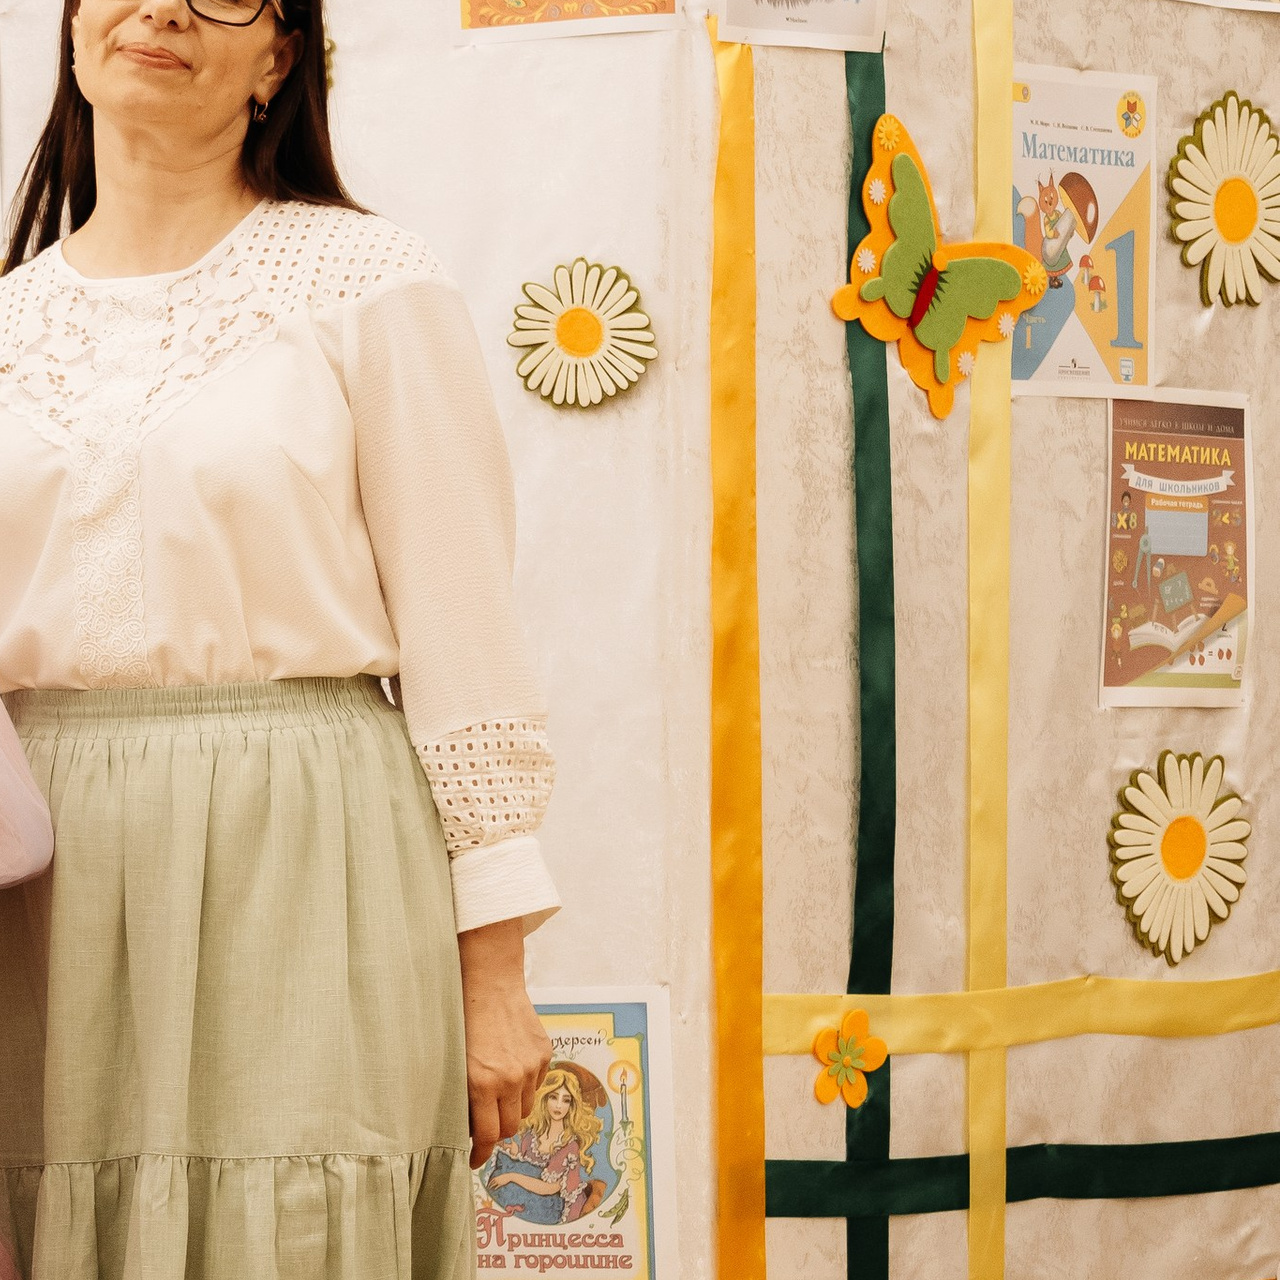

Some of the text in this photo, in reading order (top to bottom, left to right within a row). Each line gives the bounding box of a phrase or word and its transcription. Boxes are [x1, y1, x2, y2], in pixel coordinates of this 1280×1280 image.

[1022, 131, 1136, 168] Математика
[1105, 230, 1143, 349] 1
[1124, 440, 1232, 467] МАТЕМАТИКА
[1134, 476, 1220, 495] ДЛЯ ШКОЛЬНИКОВ
[1151, 498, 1178, 508] Рабочая
[1179, 501, 1204, 510] тетрадь
[477, 1205, 625, 1252] Принцесса
[477, 1254, 633, 1273] на горошине
